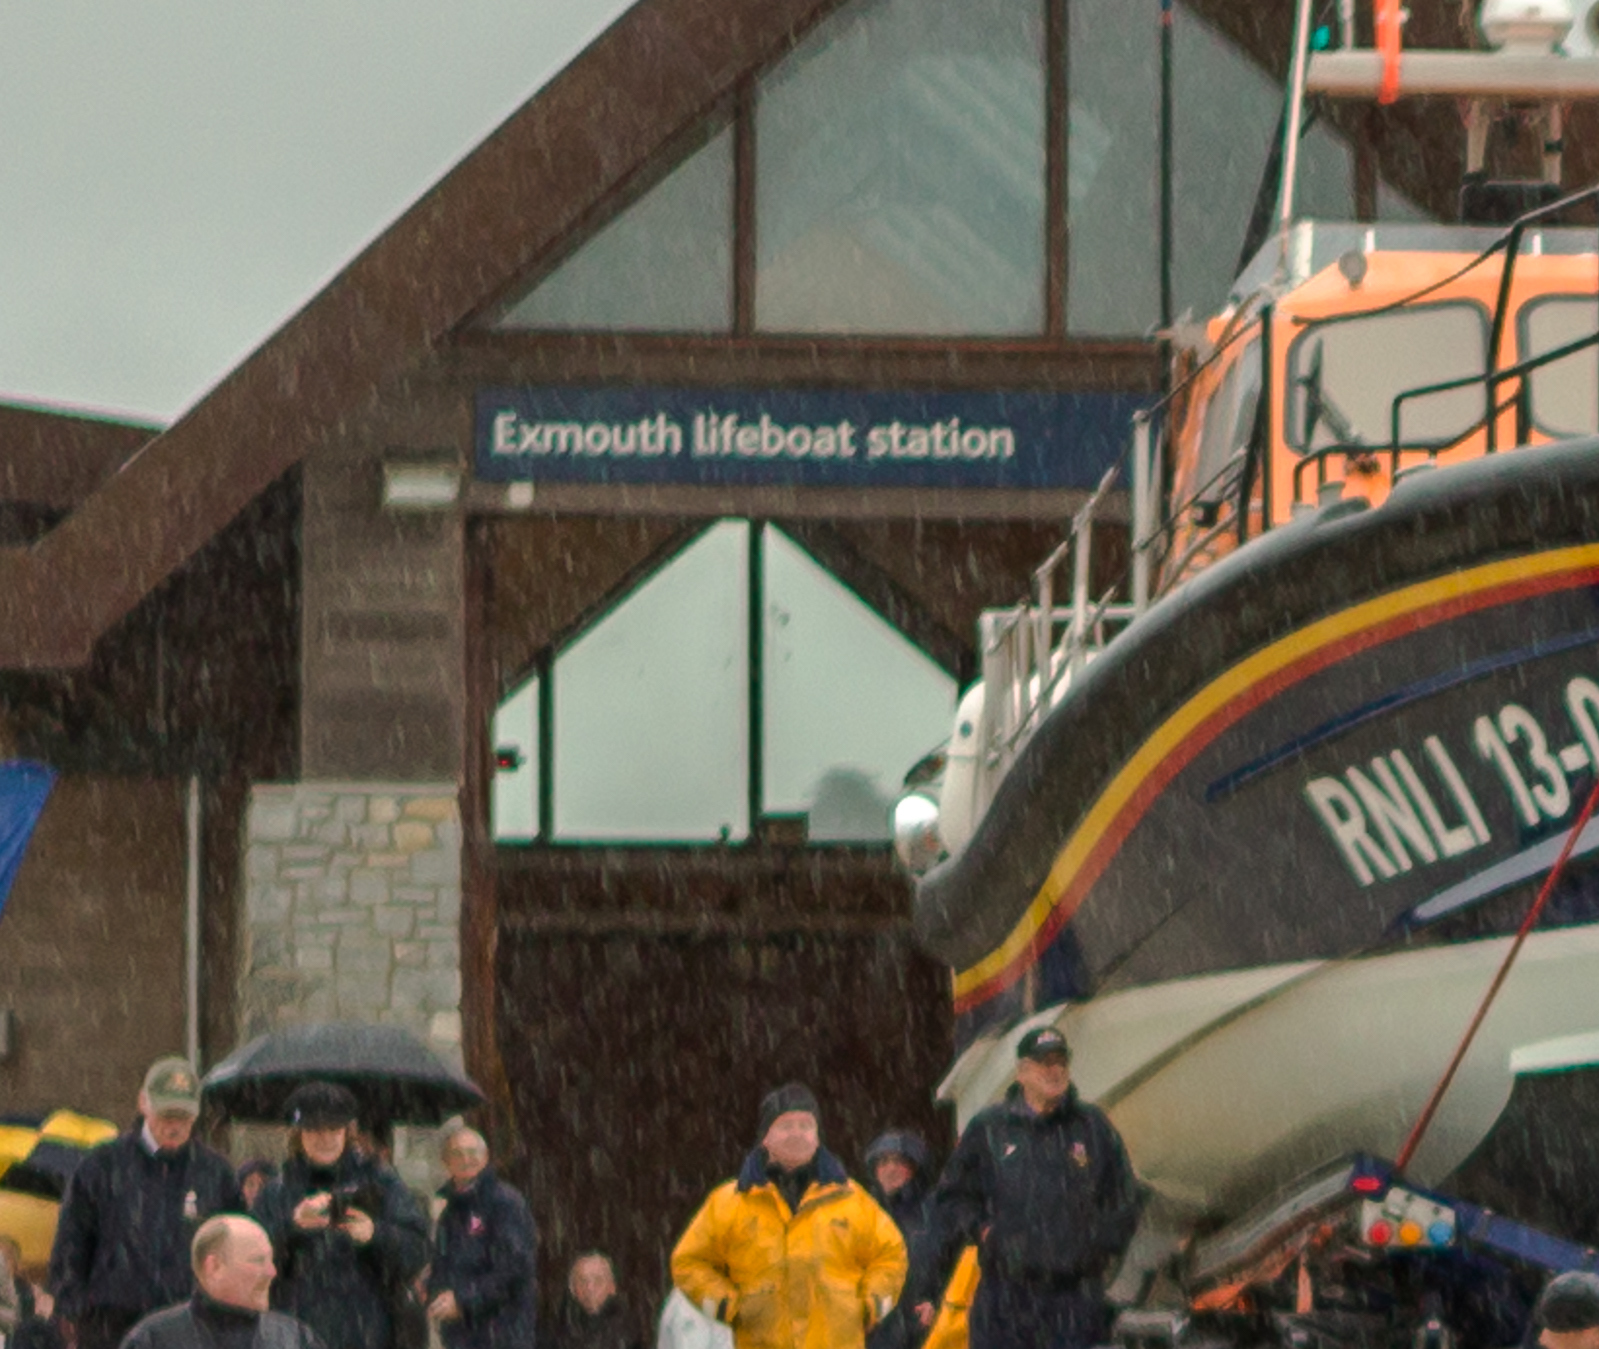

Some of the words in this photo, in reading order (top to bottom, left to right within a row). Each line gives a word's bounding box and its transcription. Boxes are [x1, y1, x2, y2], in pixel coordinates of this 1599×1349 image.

[493, 411, 682, 457] Exmouth
[694, 411, 855, 457] lifeboat
[868, 417, 1016, 459] station
[1305, 734, 1491, 887] RNLI
